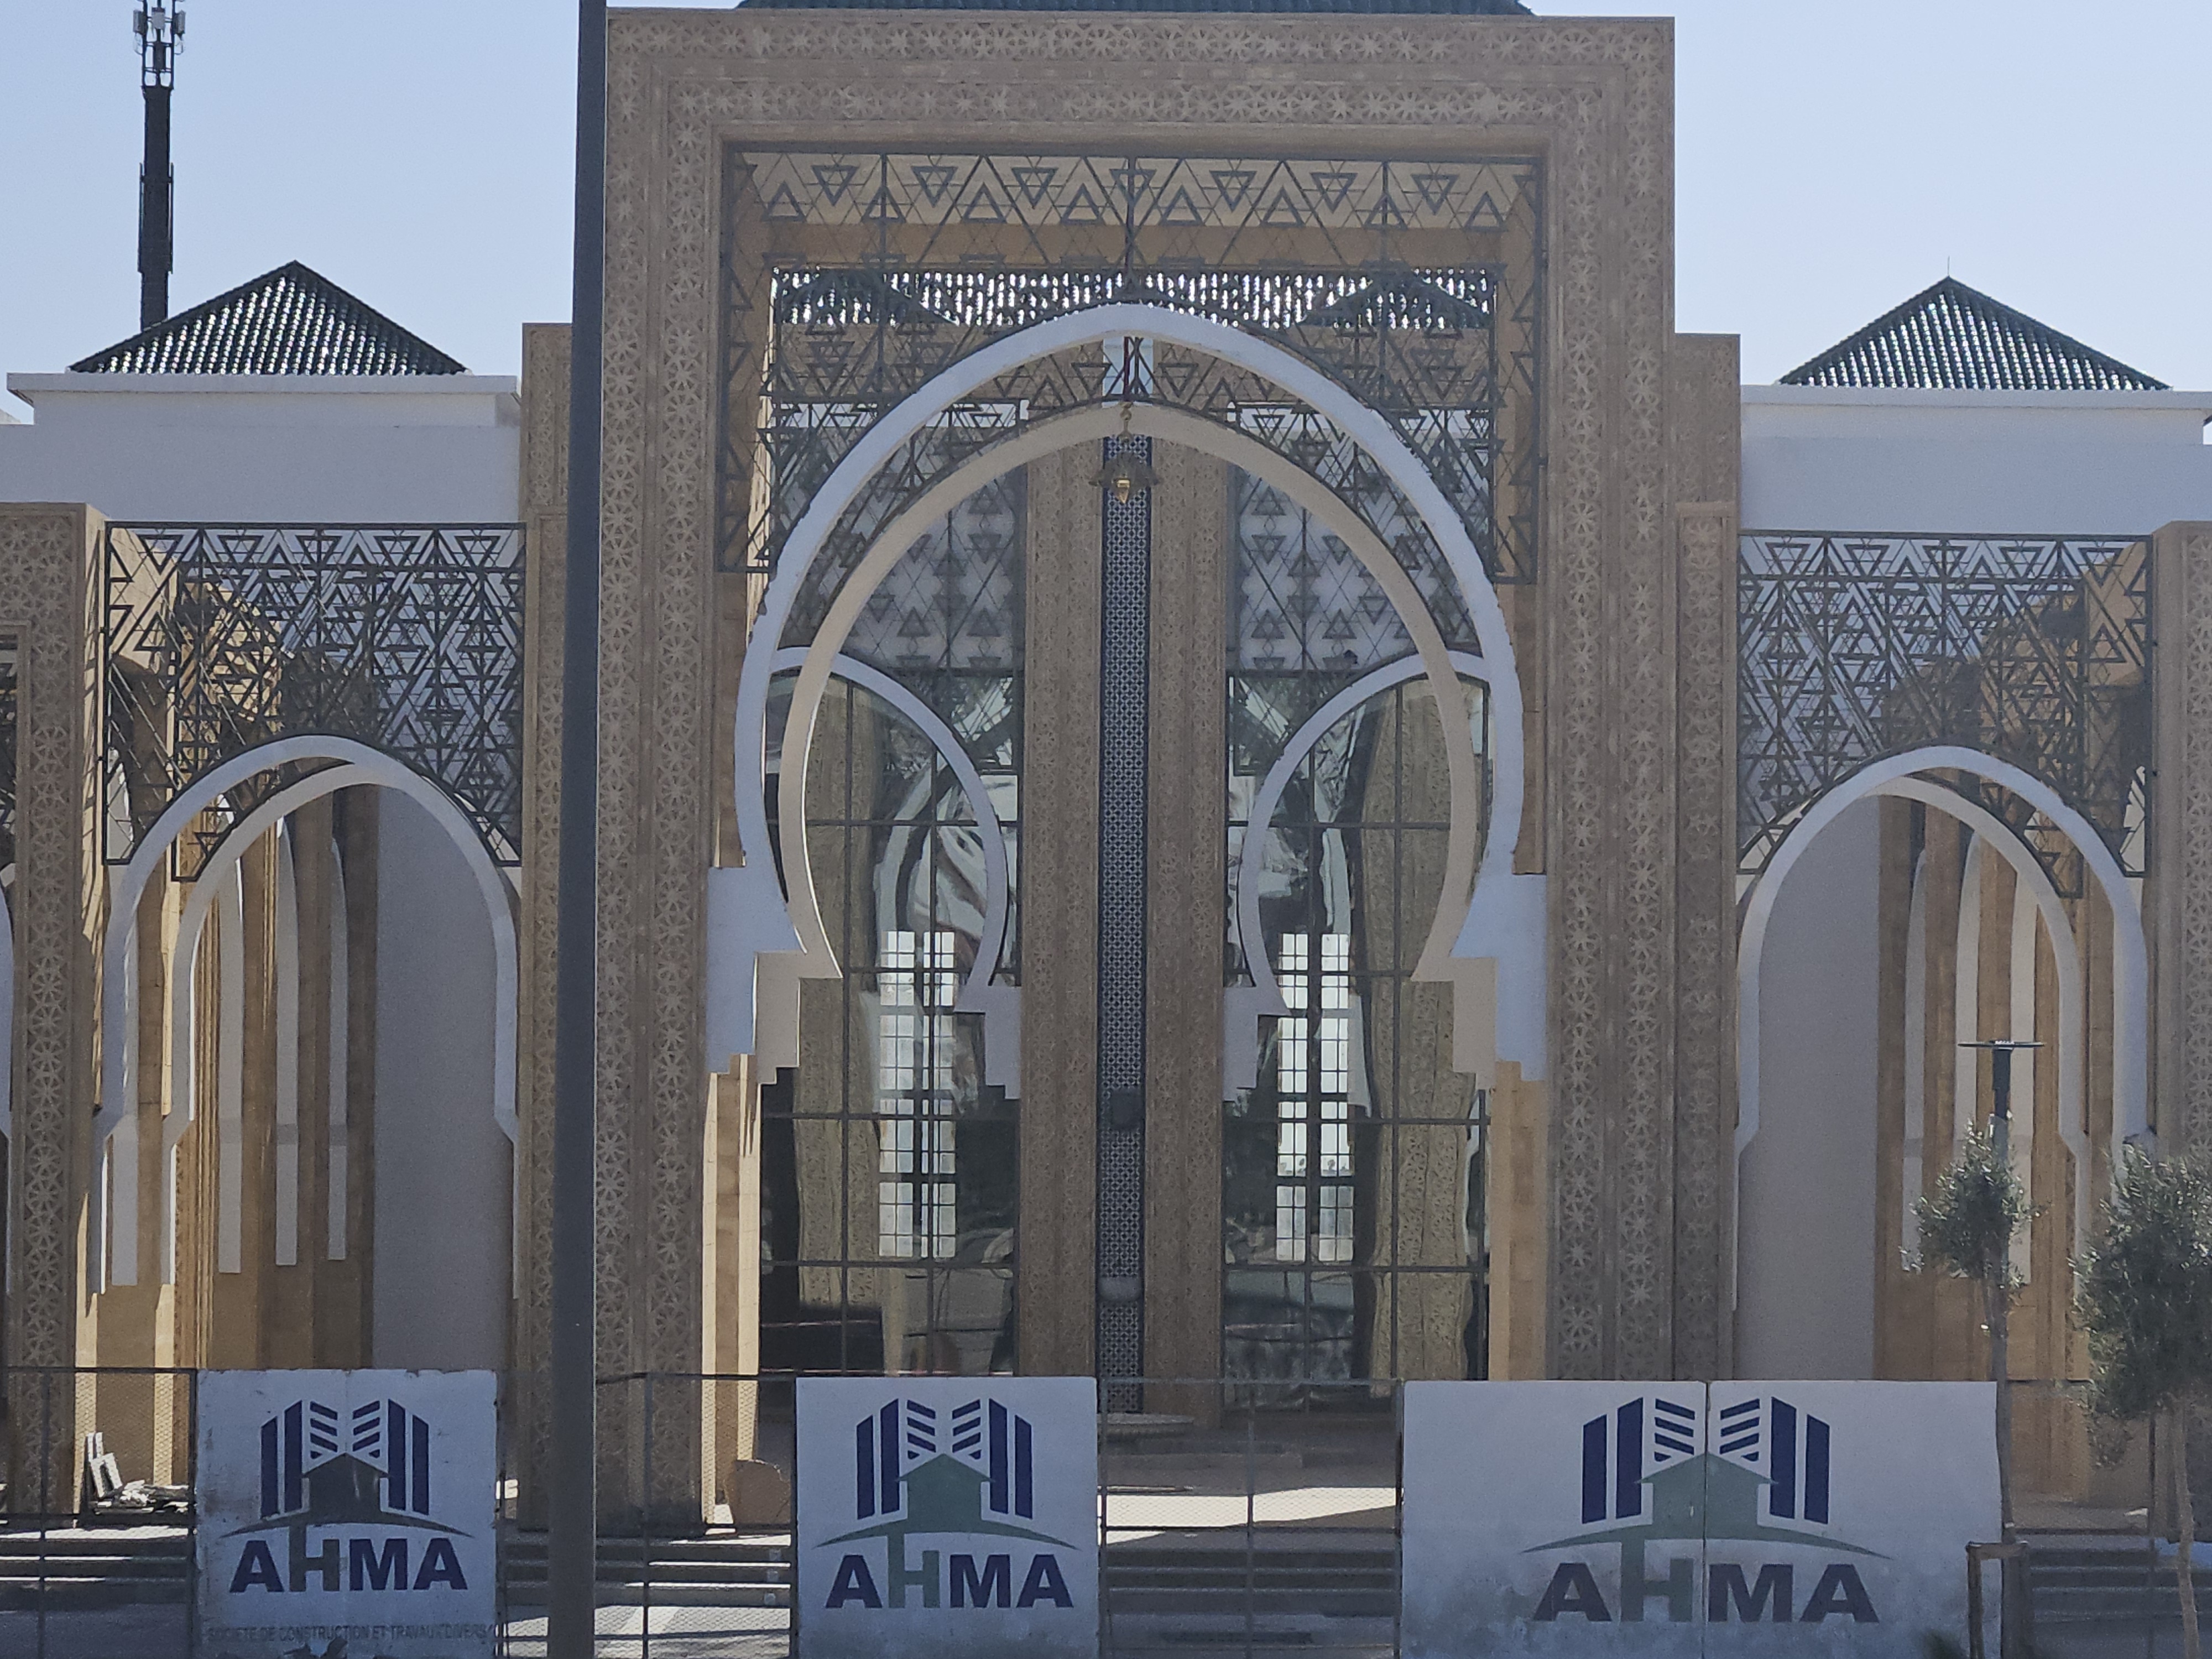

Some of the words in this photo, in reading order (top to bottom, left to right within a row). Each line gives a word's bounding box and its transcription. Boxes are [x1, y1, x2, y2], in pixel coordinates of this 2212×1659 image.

[229, 1537, 468, 1593] AHMA
[825, 1550, 1074, 1608] AHMA
[1533, 1557, 1880, 1623] AHMA
[279, 1625, 369, 1641] CONSTRUCTION
[373, 1625, 387, 1640] ET
